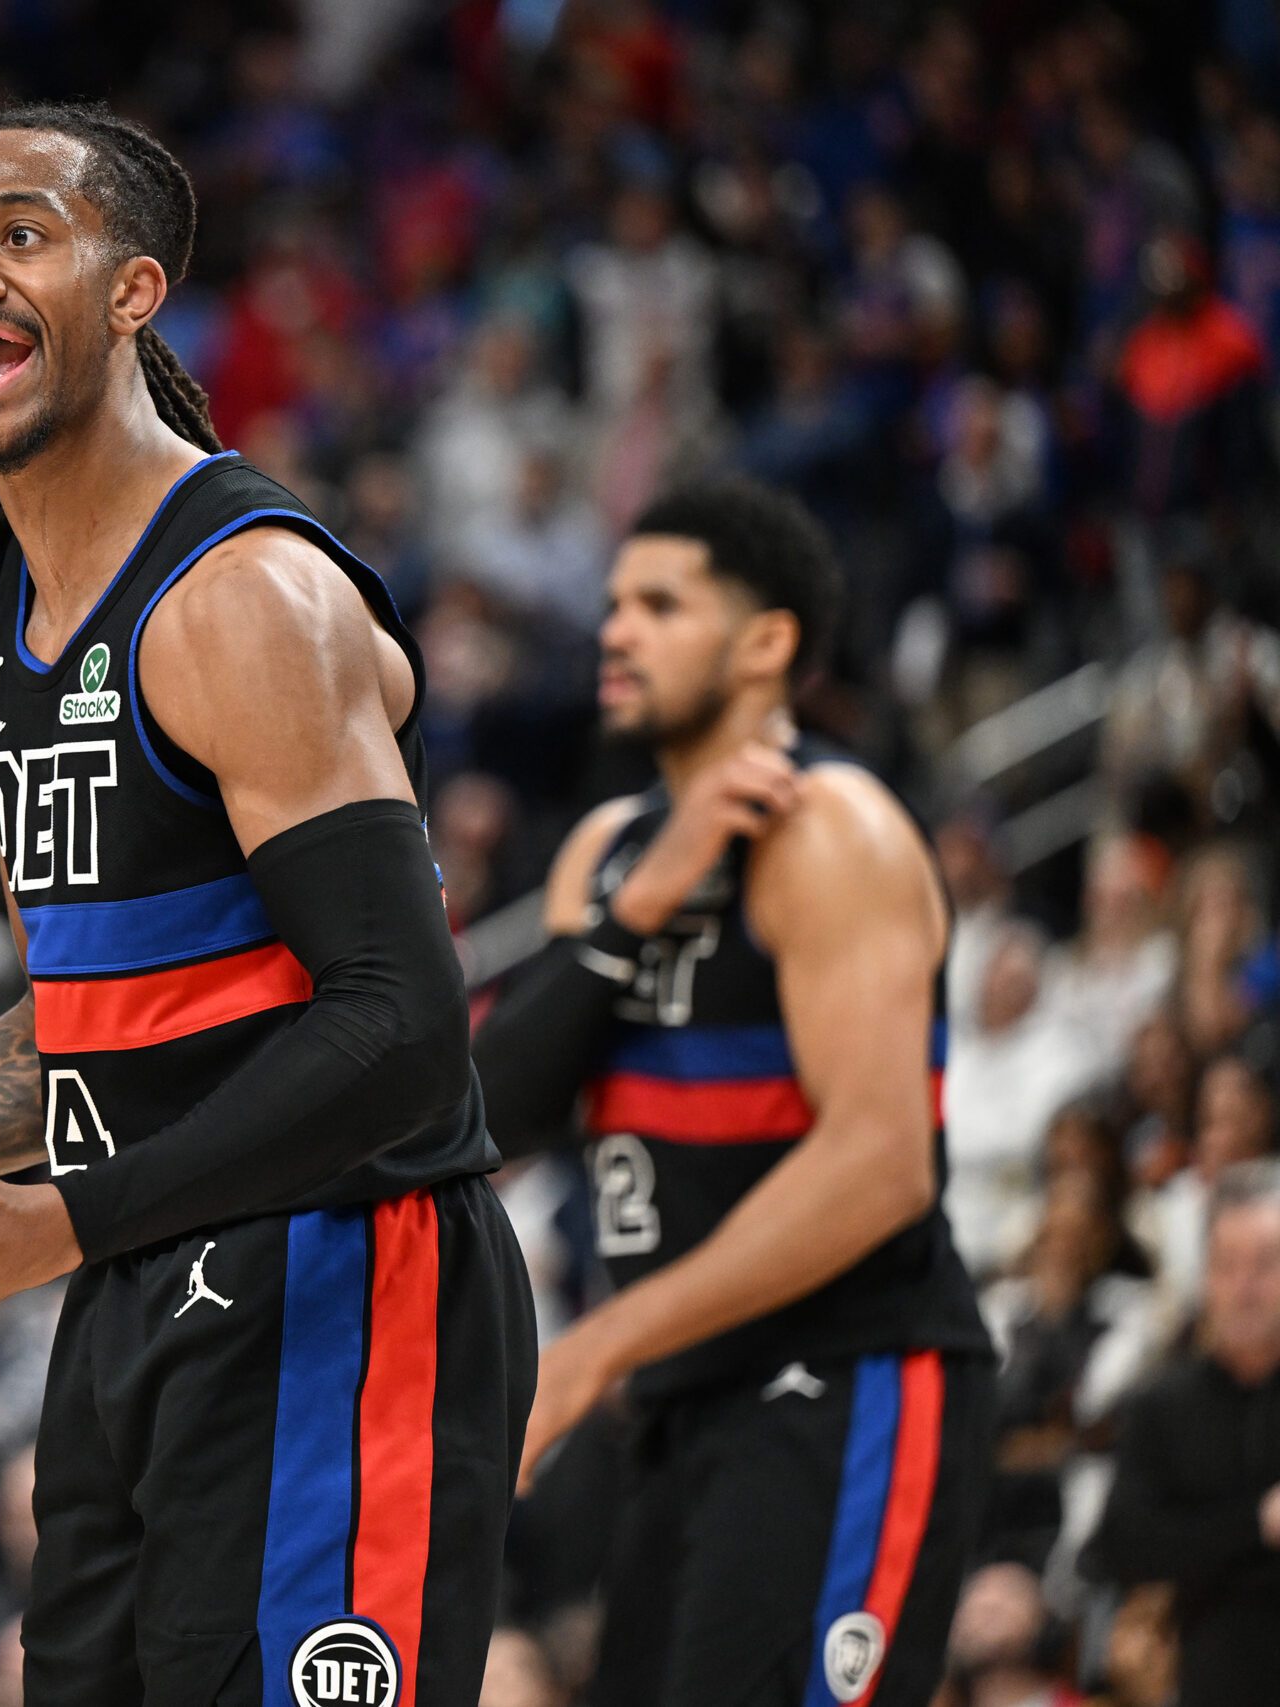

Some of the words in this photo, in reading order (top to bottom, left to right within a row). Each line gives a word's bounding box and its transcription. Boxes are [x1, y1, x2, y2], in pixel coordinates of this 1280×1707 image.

[63, 695, 116, 720] StockX
[45, 1069, 116, 1176] 4
[311, 1659, 382, 1704] DET
